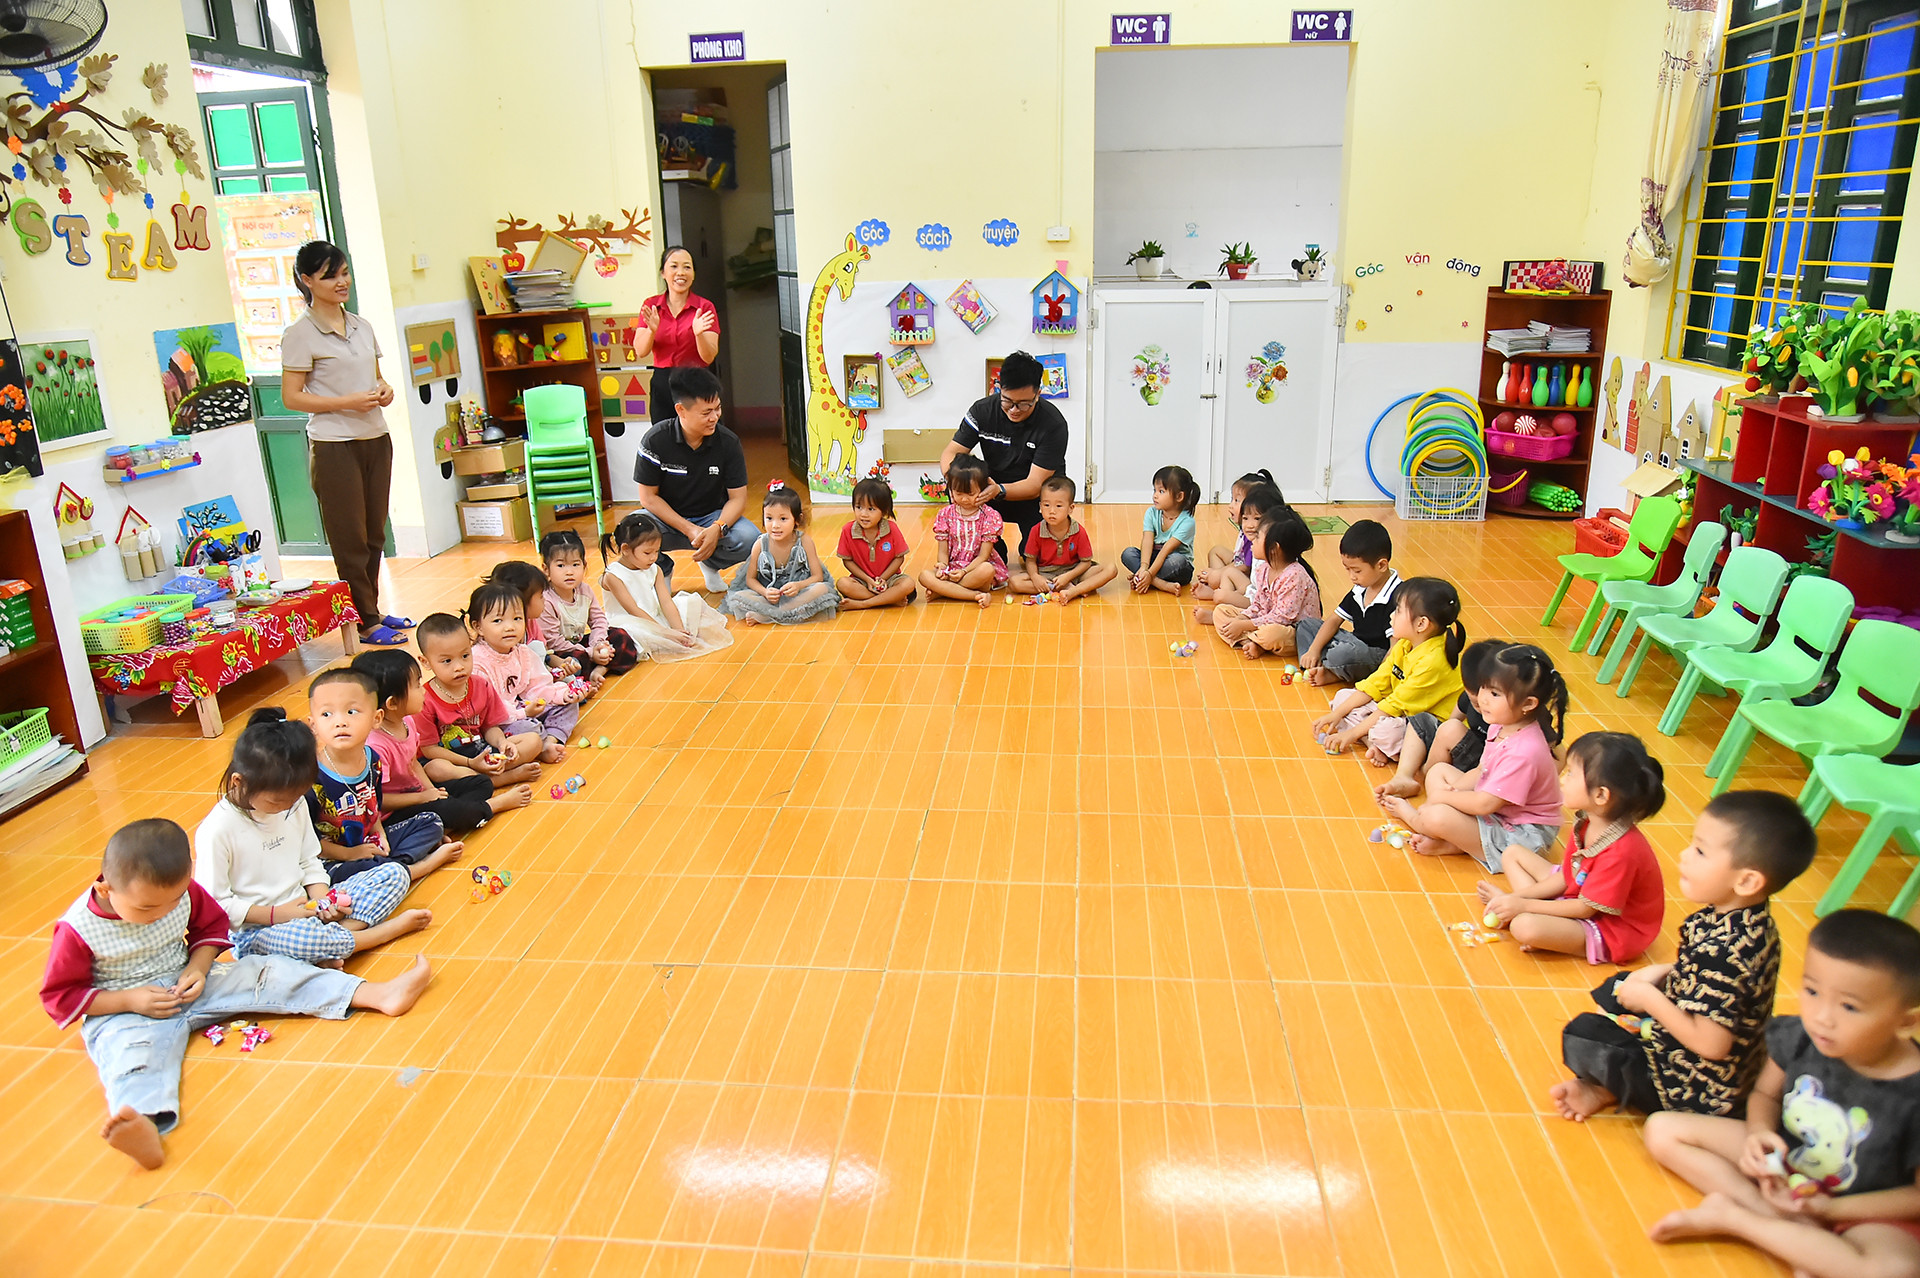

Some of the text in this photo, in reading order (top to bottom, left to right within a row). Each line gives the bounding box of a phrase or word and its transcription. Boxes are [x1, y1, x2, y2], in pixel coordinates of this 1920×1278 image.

[1115, 17, 1148, 34] WC
[1296, 13, 1329, 30] WC
[1304, 31, 1319, 39] NỮ
[692, 37, 743, 59] PHÒNG KHO
[10, 197, 211, 282] STEAM
[860, 224, 1018, 246] Góc sách truyện
[1355, 252, 1481, 278] Góc vận động
[610, 331, 617, 345] 1
[600, 349, 636, 363] 3 4
